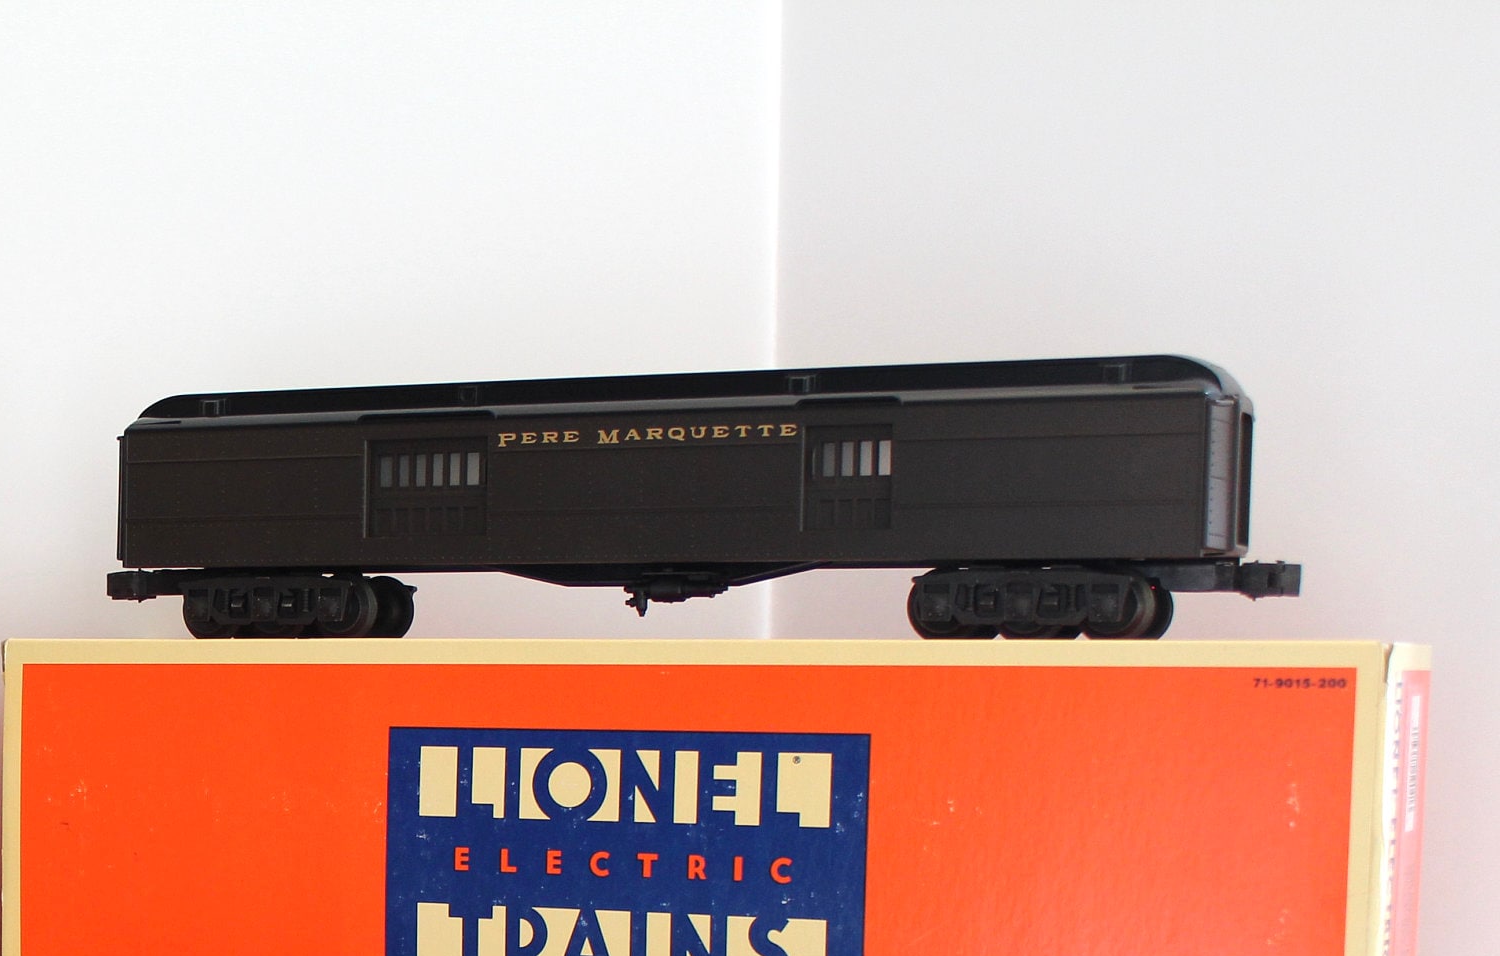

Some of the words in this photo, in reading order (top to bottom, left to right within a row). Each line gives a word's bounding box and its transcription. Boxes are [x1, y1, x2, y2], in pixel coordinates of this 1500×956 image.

[498, 429, 581, 447] PERE
[598, 423, 797, 444] MARQUETTE
[1253, 677, 1347, 689] 71-9015-200
[438, 746, 816, 828] LIONEL
[453, 846, 793, 885] ELECTRIC
